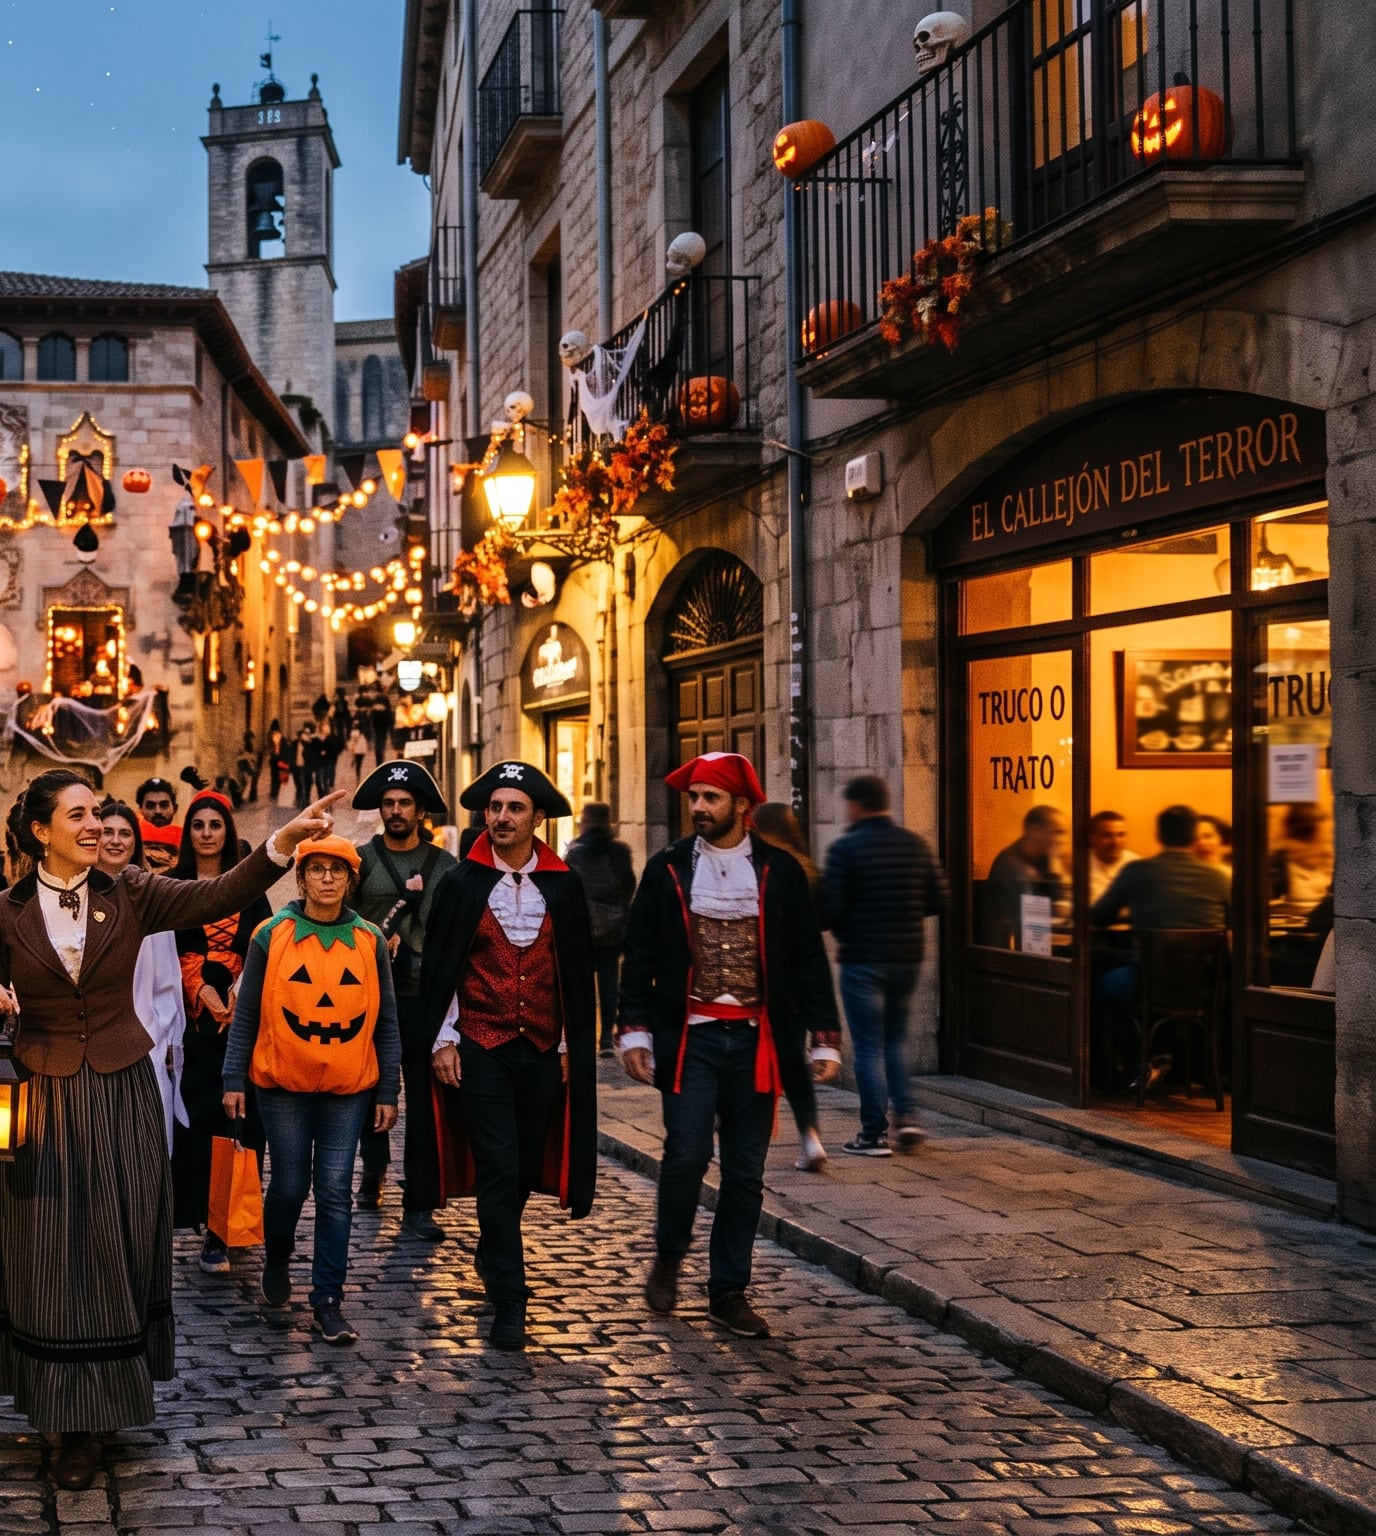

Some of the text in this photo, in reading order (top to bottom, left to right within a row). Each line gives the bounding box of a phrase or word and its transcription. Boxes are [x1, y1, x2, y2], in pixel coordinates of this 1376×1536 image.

[971, 412, 1302, 542] EL CALLEJÓN DEL TERROR
[978, 684, 1065, 726] TRUCO O
[990, 754, 1054, 793] TRATO
